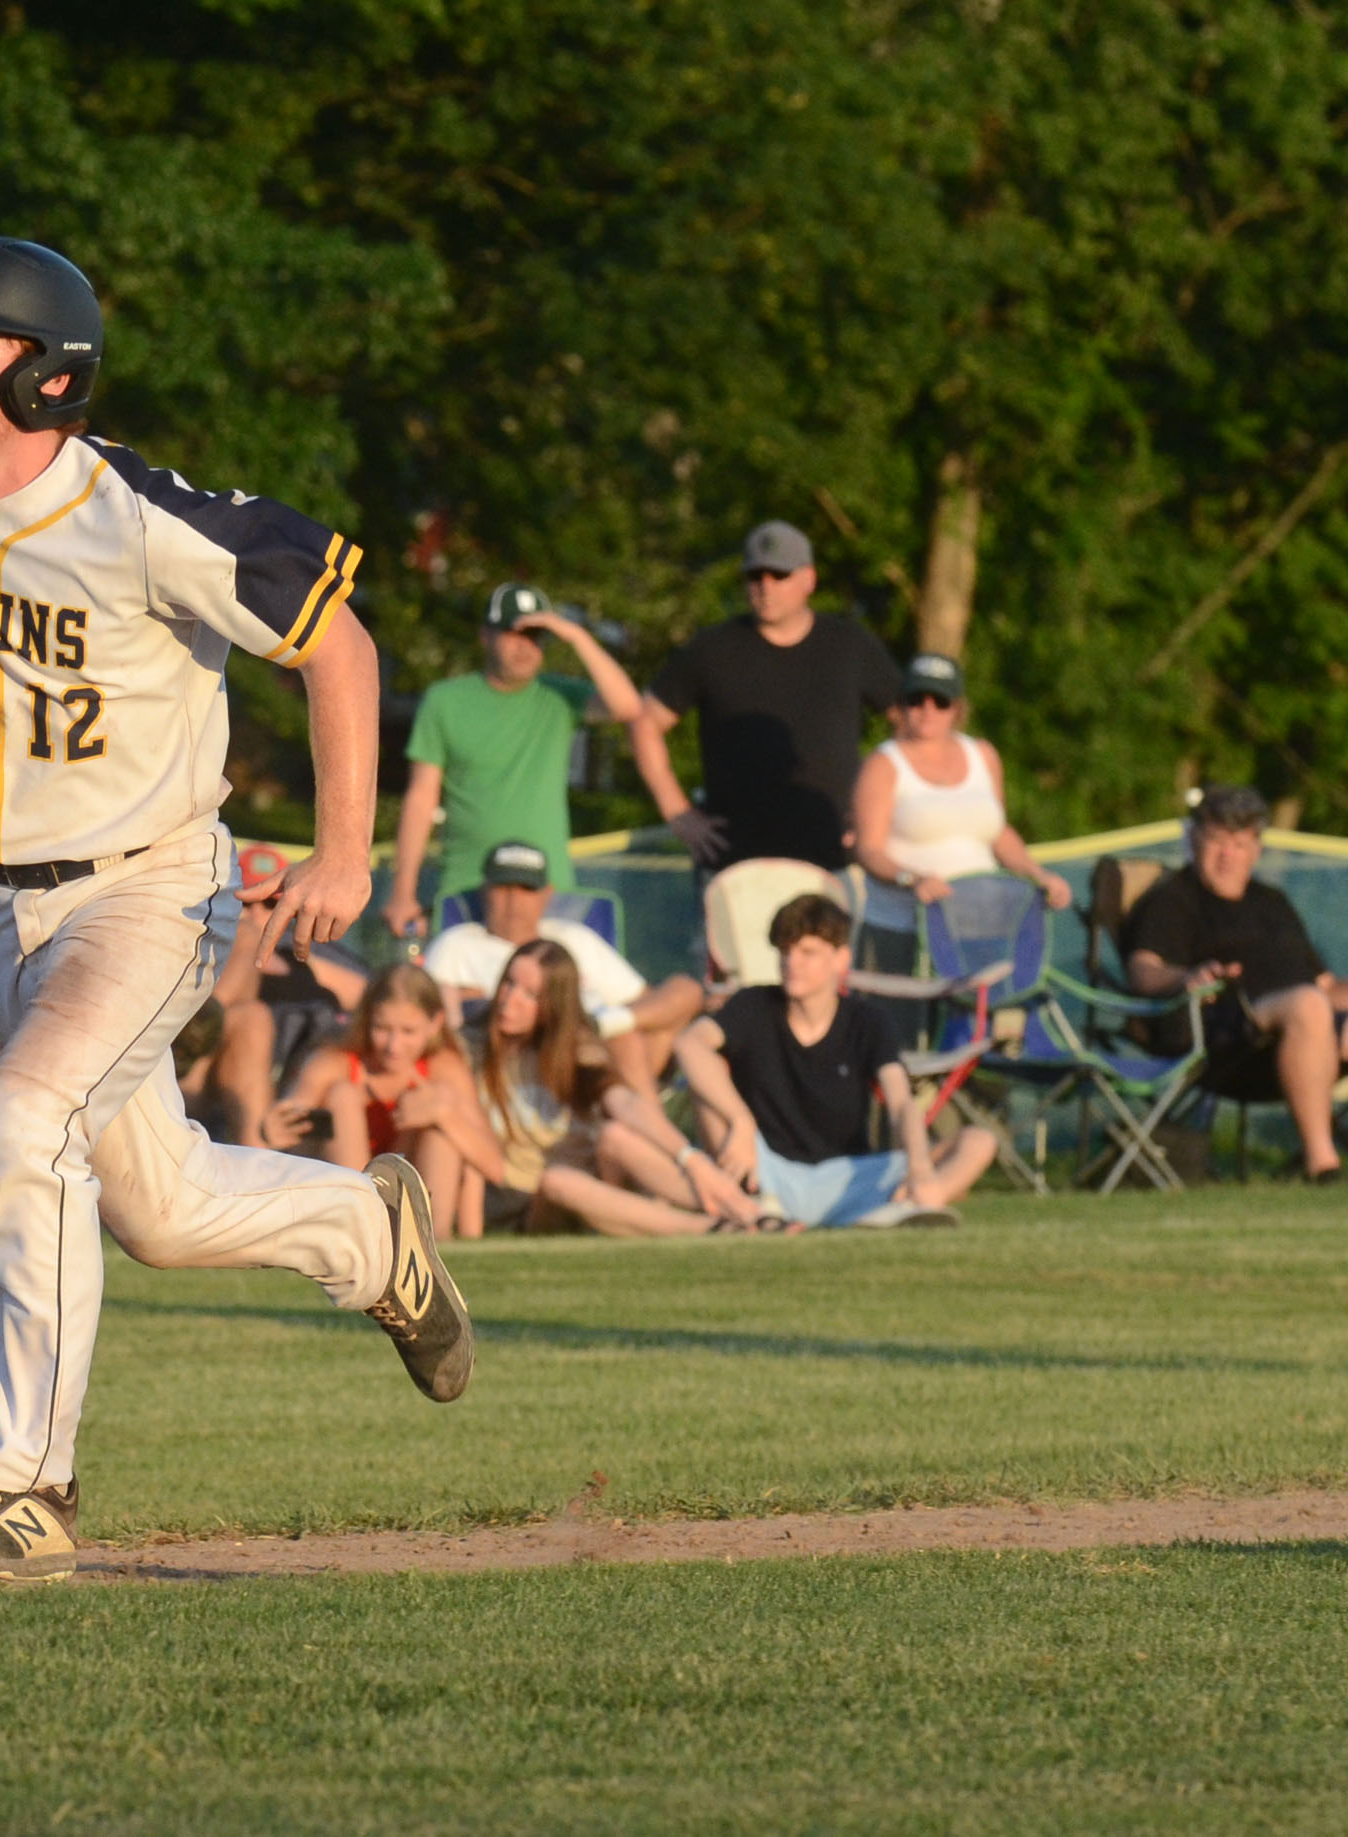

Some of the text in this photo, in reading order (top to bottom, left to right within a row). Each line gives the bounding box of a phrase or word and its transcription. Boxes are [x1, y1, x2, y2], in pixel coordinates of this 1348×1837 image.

[63, 342, 92, 351] EASTON
[26, 683, 108, 765] 12
[4, 1505, 48, 1551] N
